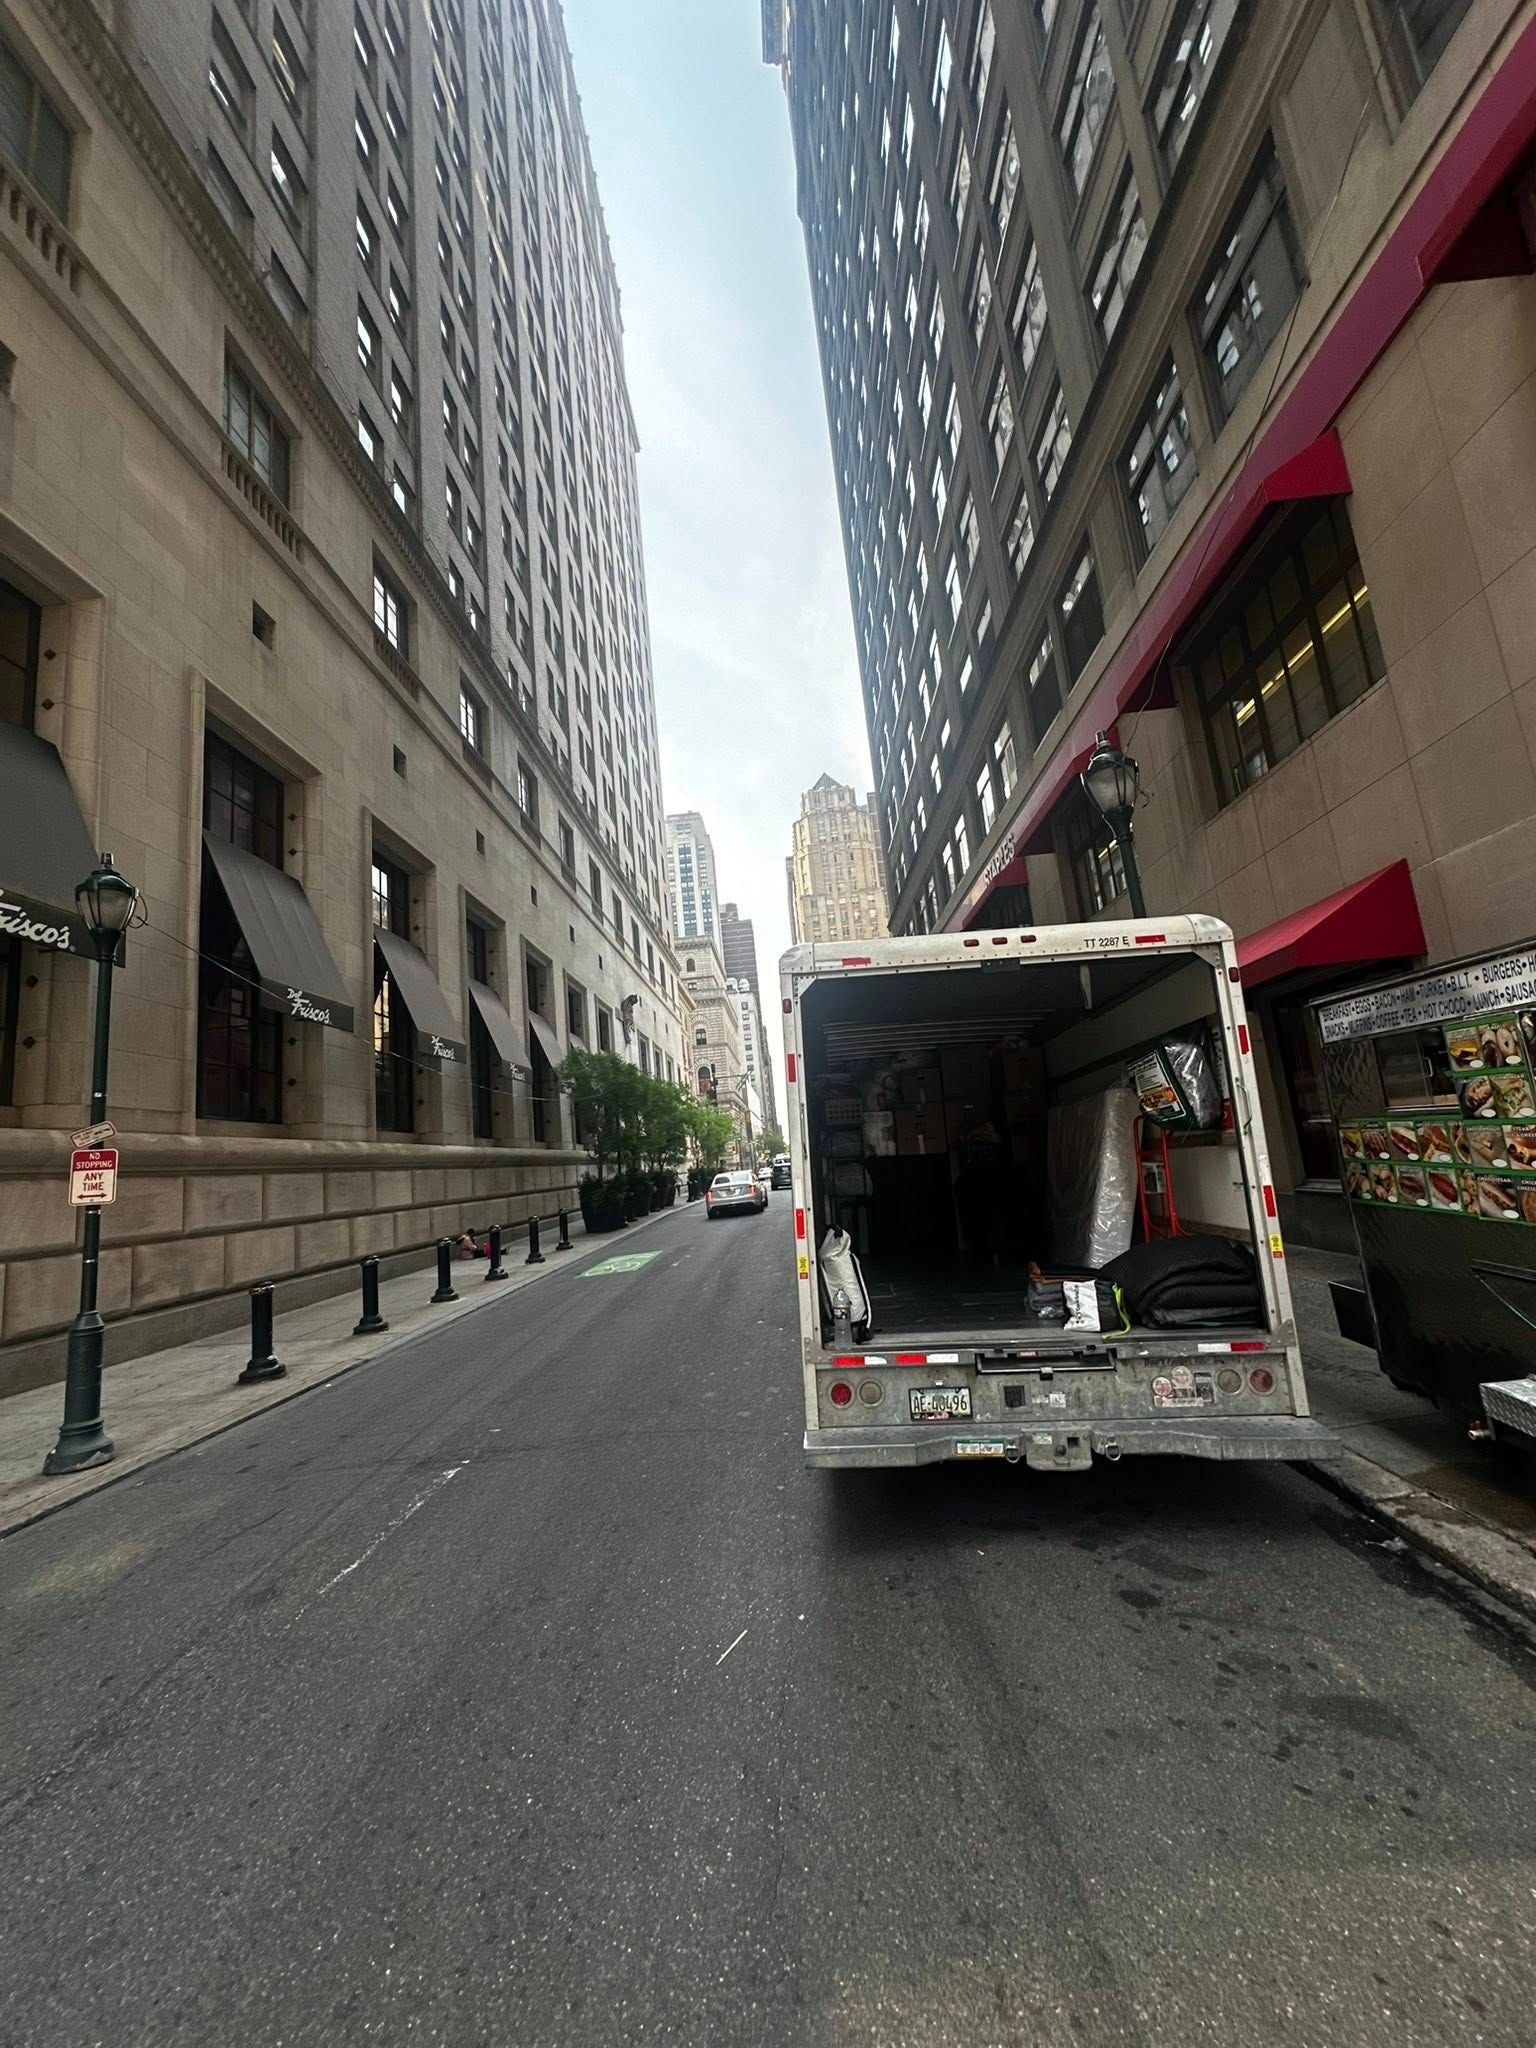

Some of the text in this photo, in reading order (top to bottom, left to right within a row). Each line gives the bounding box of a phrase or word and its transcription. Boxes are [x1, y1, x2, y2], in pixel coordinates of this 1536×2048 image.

[1083, 935, 1130, 948] TT 2287 E
[1481, 958, 1522, 984] BURGERS
[1422, 1002, 1437, 1020] HOT
[1472, 988, 1500, 1012] LUNCH
[88, 1152, 101, 1160] NO
[76, 1160, 113, 1170] STOPPING
[84, 1172, 104, 1182] ANY
[83, 1181, 104, 1192] TIME
